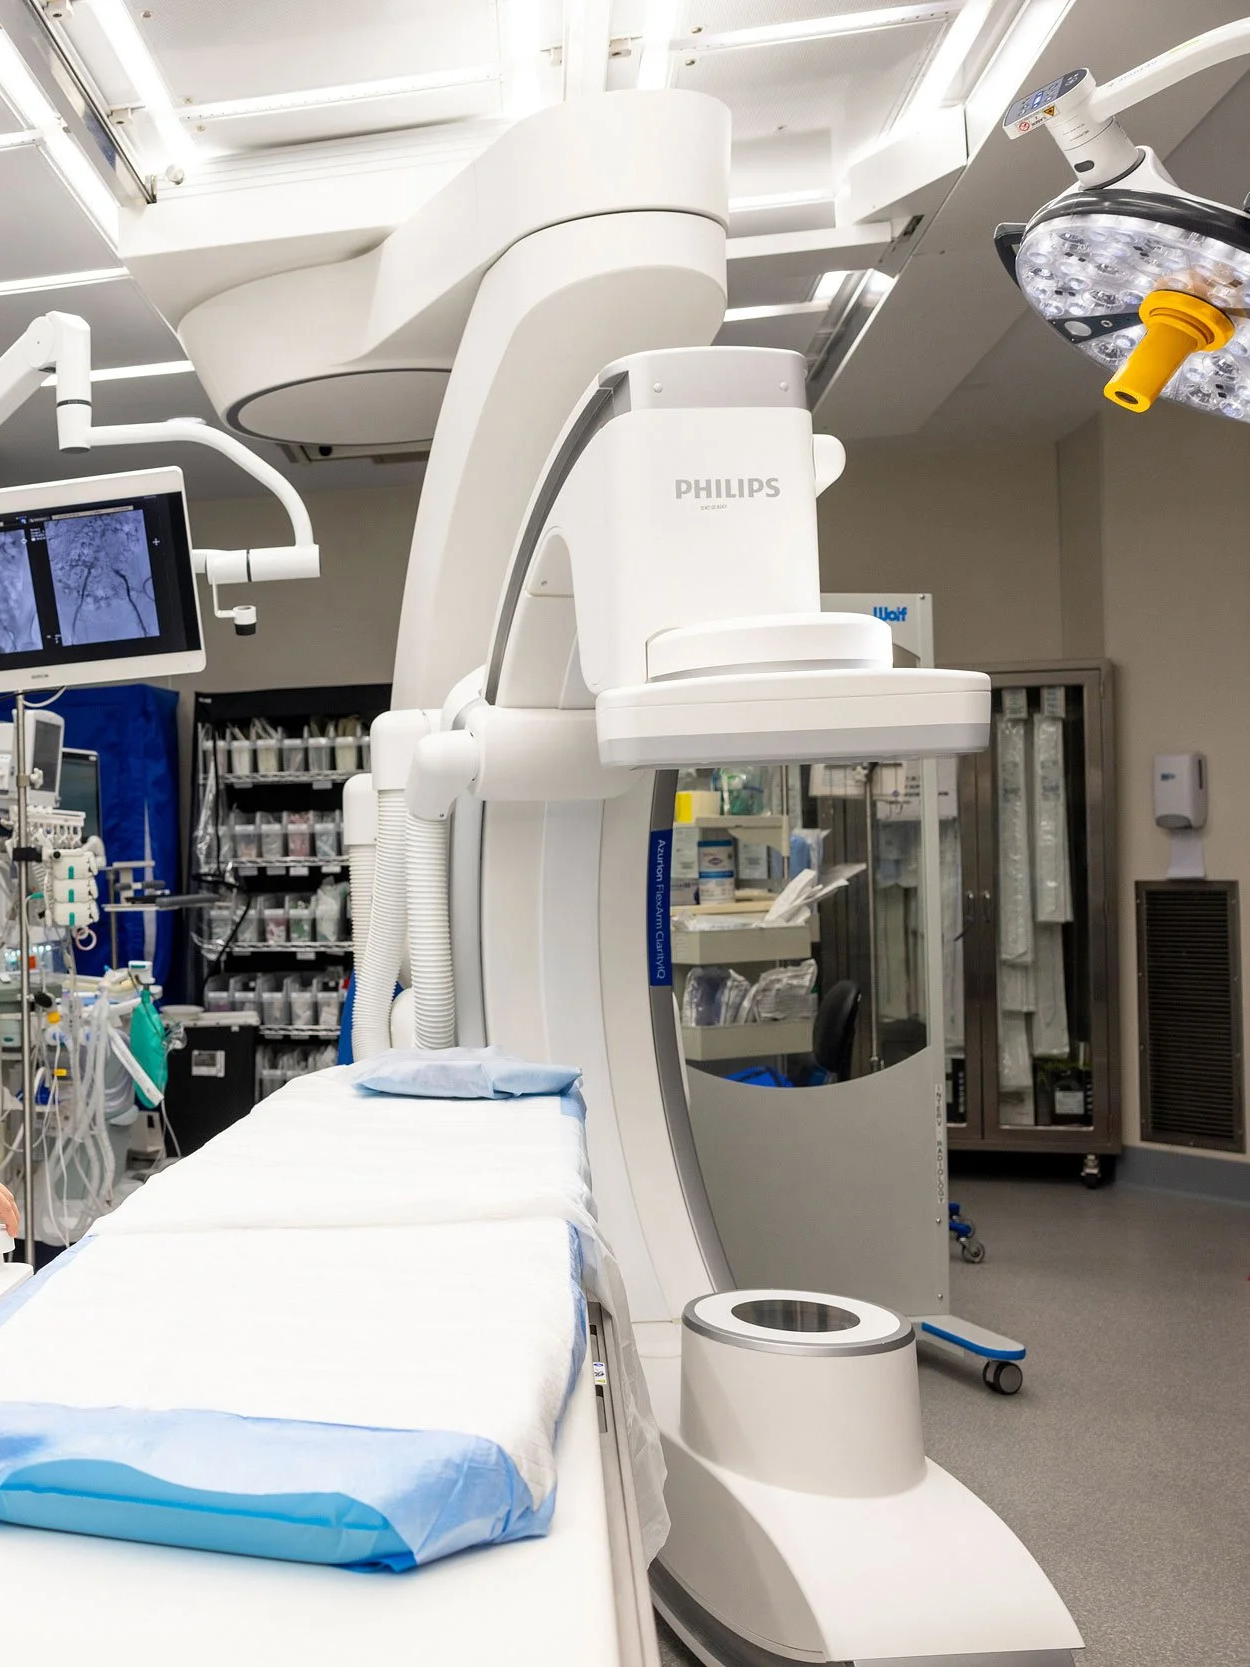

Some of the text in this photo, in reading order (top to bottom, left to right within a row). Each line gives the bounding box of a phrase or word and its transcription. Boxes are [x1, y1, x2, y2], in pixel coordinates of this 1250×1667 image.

[675, 478, 781, 499] PHILIPS
[655, 839, 666, 979] Azurion FlexArm ClarityIQ
